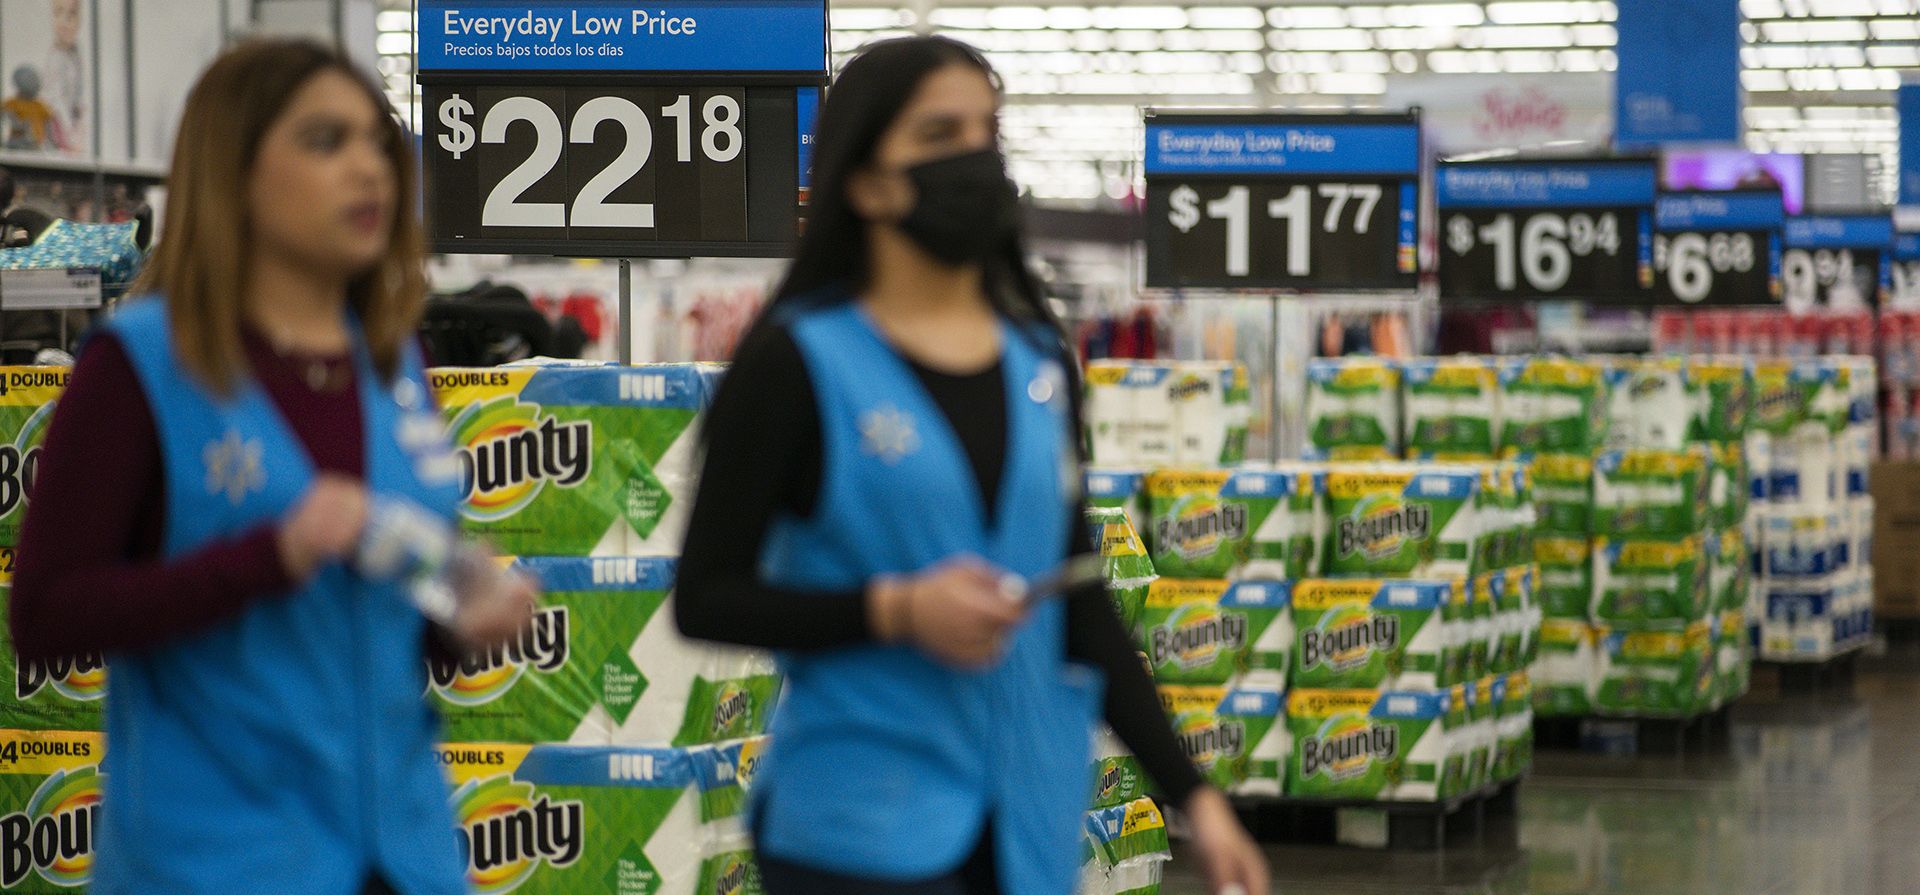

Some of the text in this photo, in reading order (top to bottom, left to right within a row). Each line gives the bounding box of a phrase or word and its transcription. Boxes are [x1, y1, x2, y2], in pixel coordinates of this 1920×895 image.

[444, 10, 697, 42] Everyday Low Price
[444, 43, 624, 60] Precios bajos todos los días
[1158, 130, 1336, 155] Everyday Low Price
[11, 373, 72, 387] DOUBLE
[432, 373, 509, 389] DOUBLES
[455, 417, 589, 500] ounty
[1159, 503, 1245, 556] Bounty
[1340, 503, 1428, 556] Bounty
[1154, 613, 1244, 664] Bounty
[1305, 614, 1396, 667] Bounty
[604, 664, 621, 673] The
[604, 674, 638, 684] Quicker
[604, 685, 632, 694] Picker
[604, 695, 632, 706] Upper
[0, 741, 91, 763] 4 DOUBLES
[1305, 724, 1395, 775] Bounty
[1, 806, 97, 885] Bou
[455, 797, 580, 872] ounty
[619, 859, 635, 869] The
[619, 870, 653, 880] Quicker
